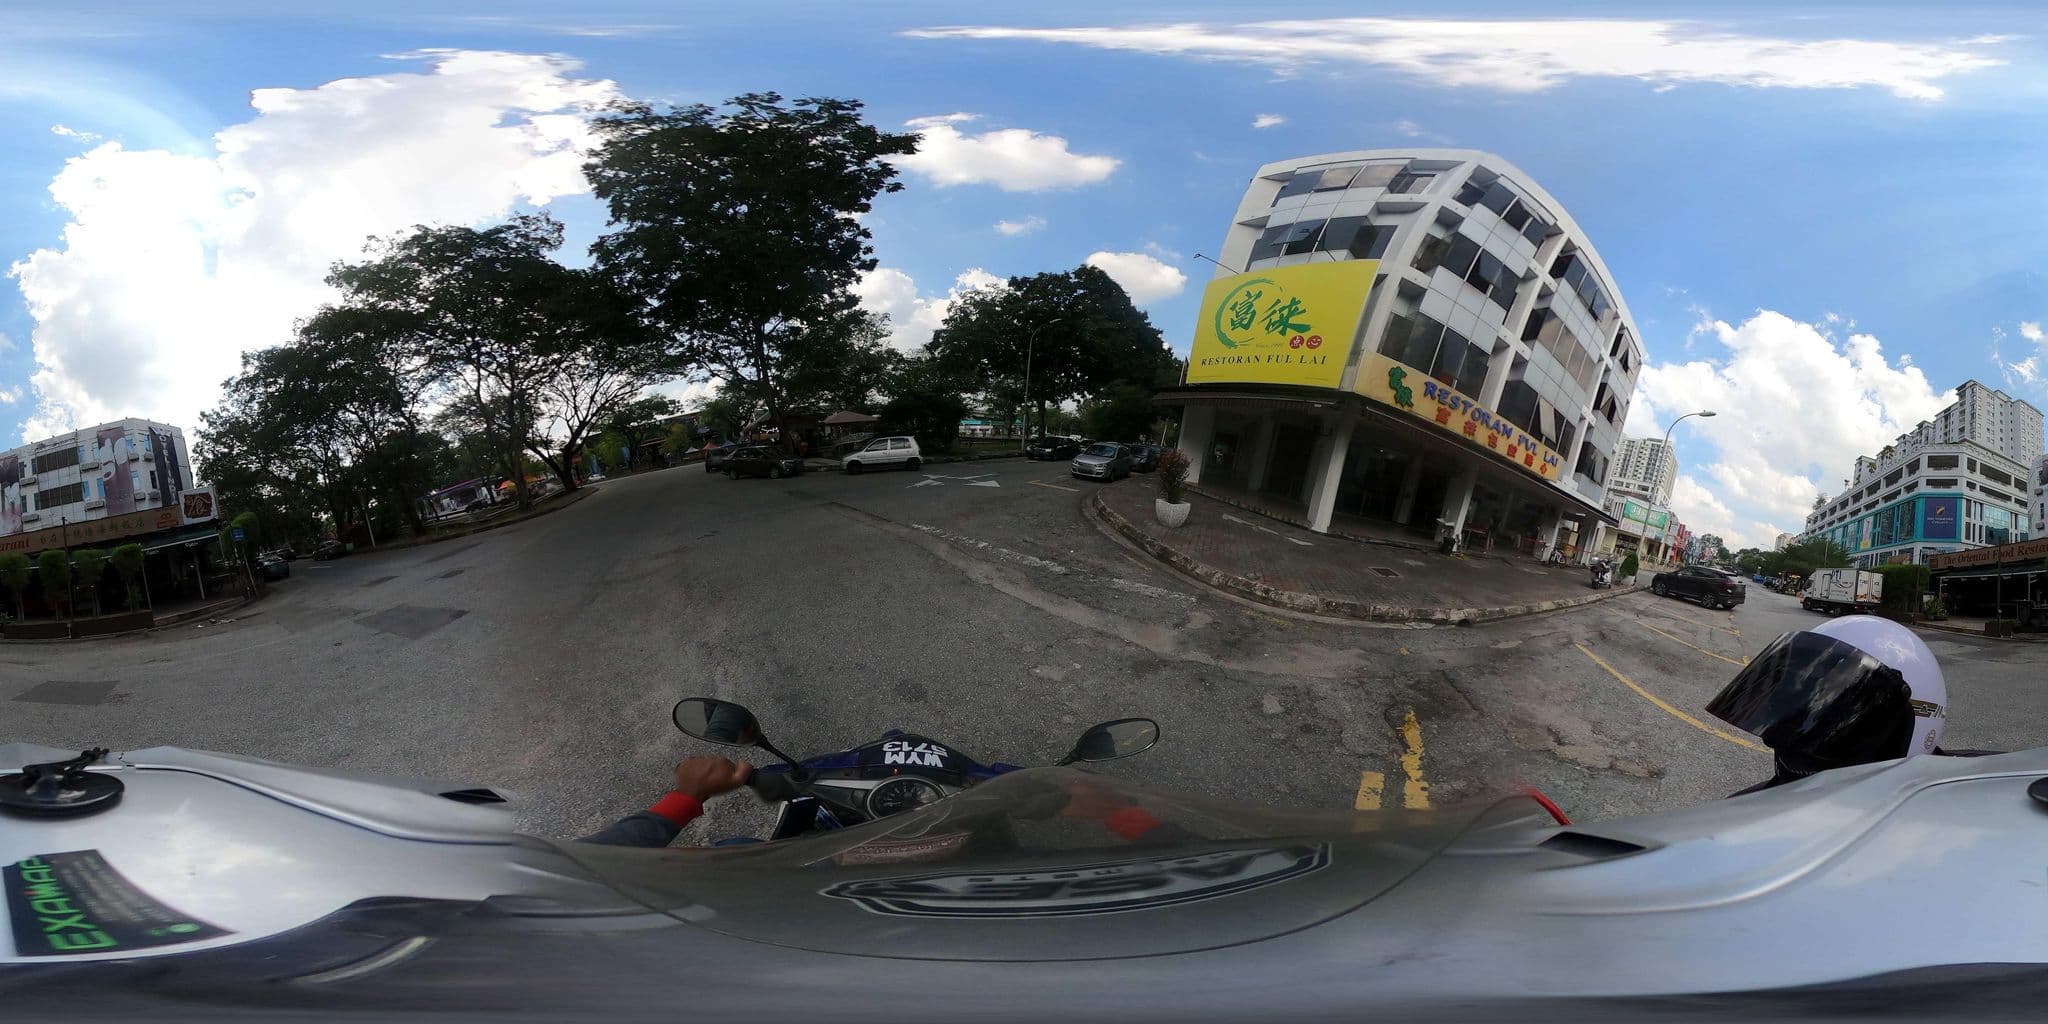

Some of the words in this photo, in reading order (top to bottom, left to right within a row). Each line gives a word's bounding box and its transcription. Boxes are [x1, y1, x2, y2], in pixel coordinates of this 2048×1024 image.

[1201, 354, 1261, 366] RESTORAN
[1267, 353, 1292, 364] FUL
[1299, 354, 1327, 365] LAI
[1424, 381, 1513, 439] RESTORAN
[1517, 434, 1538, 456] FUL
[1544, 450, 1559, 467] LAI
[1944, 556, 1957, 566] The
[1959, 550, 1990, 563] Oriental
[882, 741, 948, 758] 5713
[884, 751, 944, 767] WYM
